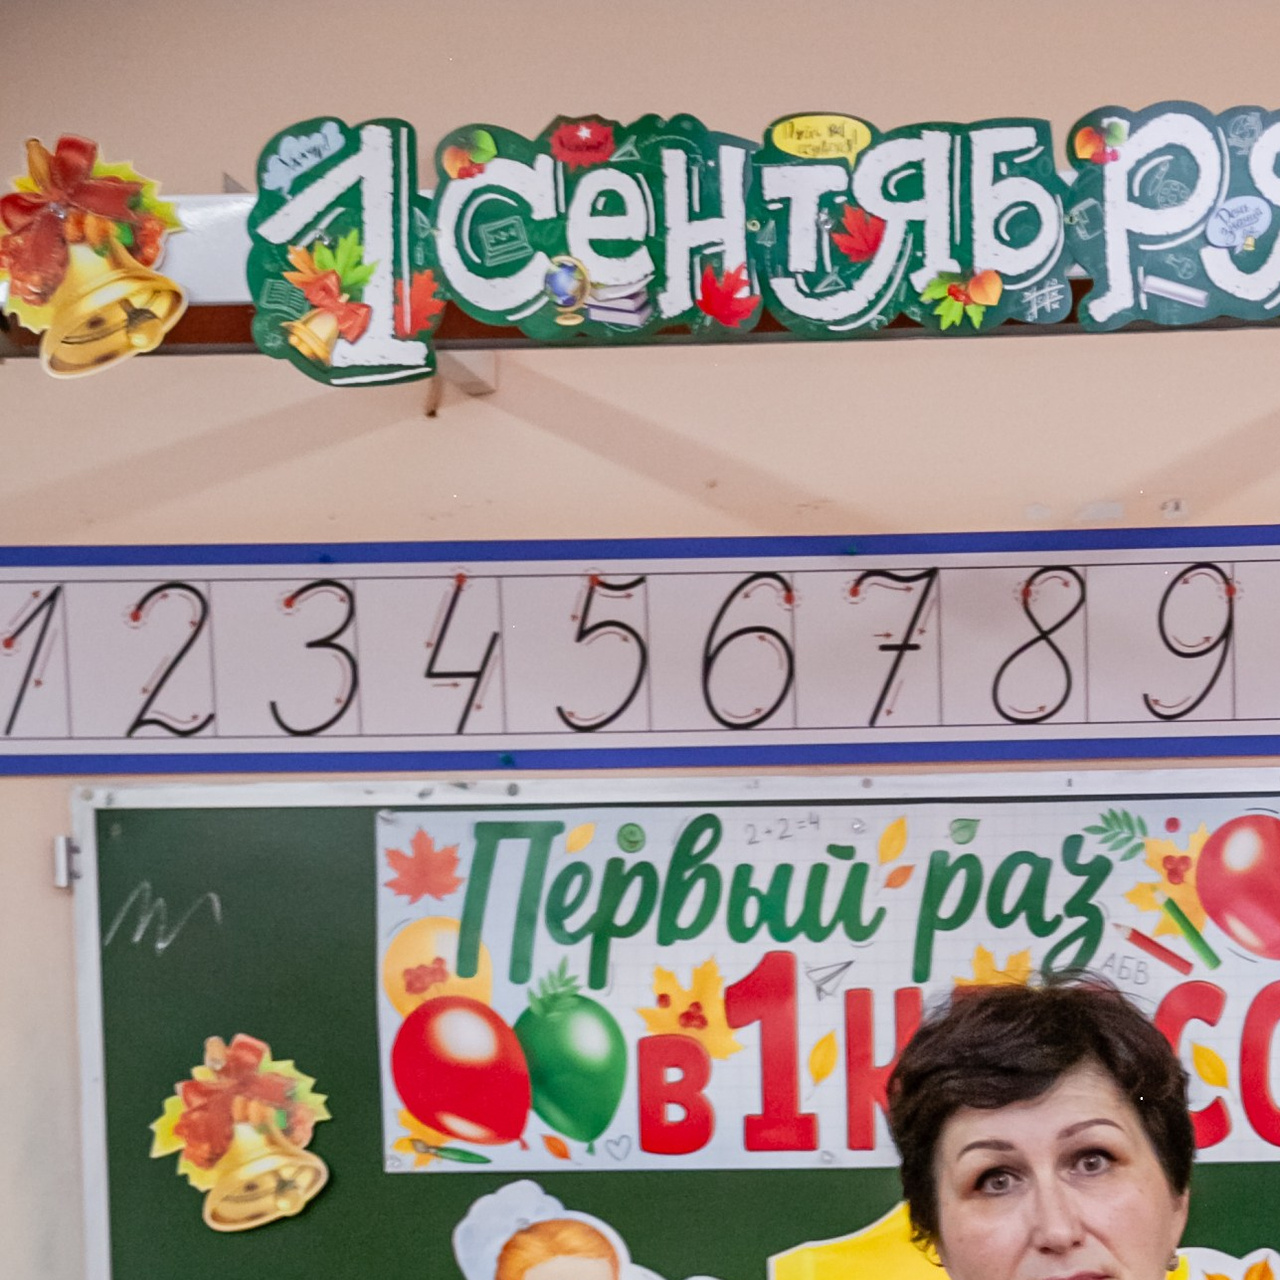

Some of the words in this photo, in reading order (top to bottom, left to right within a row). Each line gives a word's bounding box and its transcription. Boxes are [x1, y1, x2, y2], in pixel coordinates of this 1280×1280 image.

[257, 124, 430, 368] 1
[0, 585, 63, 736] 1
[129, 582, 216, 737] 2
[269, 580, 360, 735] 3
[425, 576, 500, 735] 4
[557, 575, 647, 732] 5
[702, 571, 797, 730] 6
[853, 566, 939, 726] 7
[992, 566, 1087, 724] 8
[1142, 562, 1235, 720] 9
[456, 813, 886, 990] Первый
[913, 834, 1113, 983] раз
[723, 950, 819, 1153] 1
